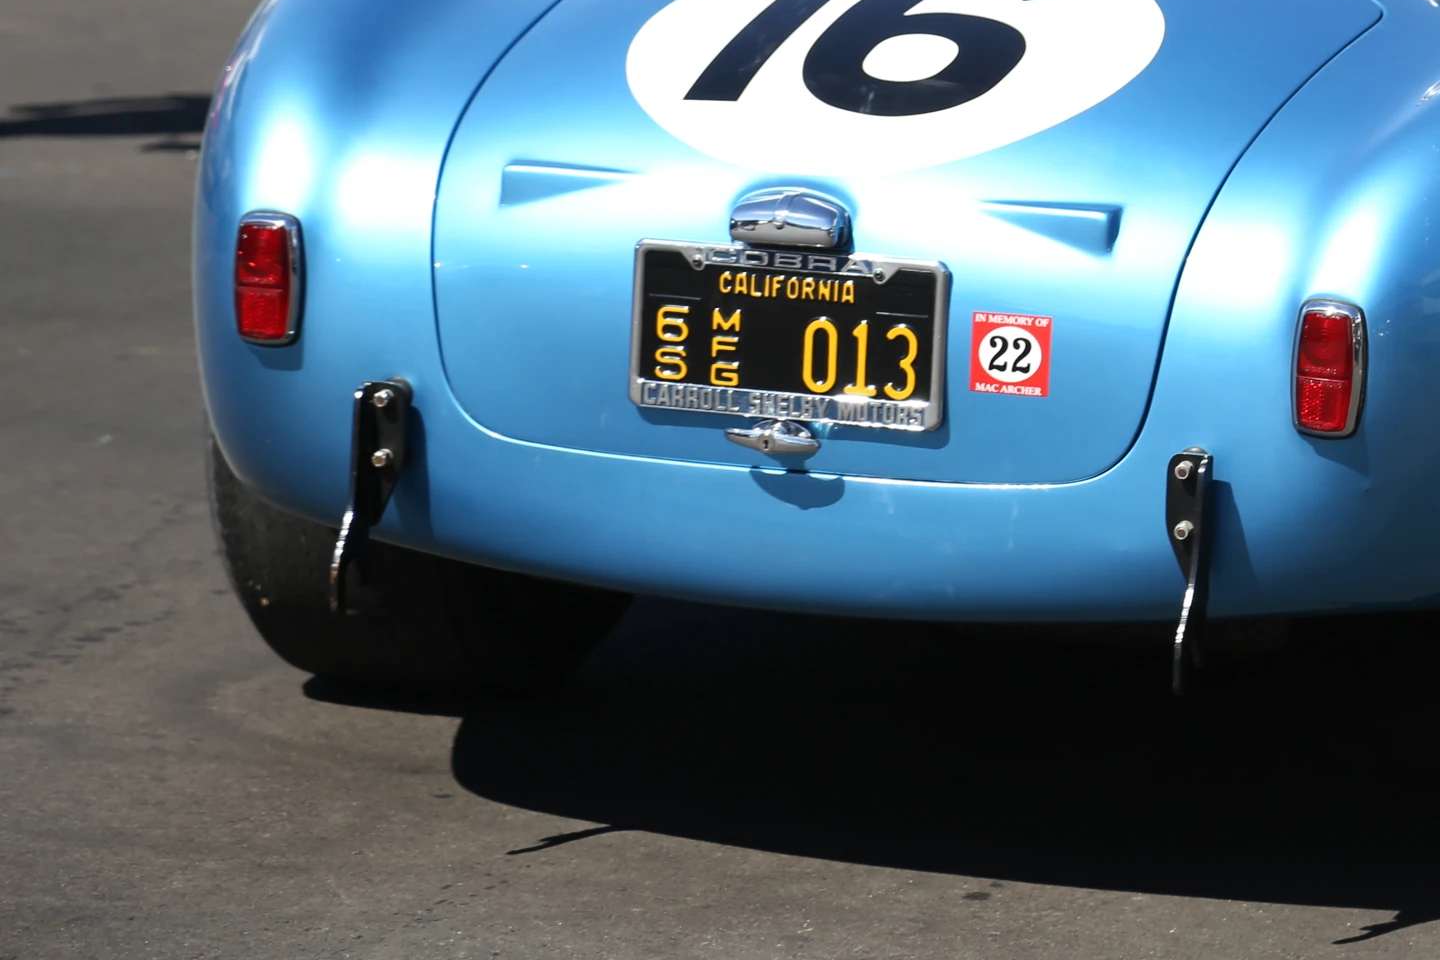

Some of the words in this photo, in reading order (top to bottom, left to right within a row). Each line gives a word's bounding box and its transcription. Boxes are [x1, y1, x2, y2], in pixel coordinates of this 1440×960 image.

[709, 247, 871, 274] COBRA
[719, 271, 855, 304] CALIFORNIA
[975, 313, 988, 323] IN
[988, 314, 1034, 326] MEMORY
[1035, 318, 1050, 327] OF
[802, 316, 918, 400] 013
[988, 335, 1032, 374] 22
[643, 382, 740, 412] CARROLL
[748, 391, 831, 419] SHELBY
[838, 398, 924, 426] MOTORS
[975, 382, 999, 392] MAC
[1000, 385, 1042, 396] ARCHER
